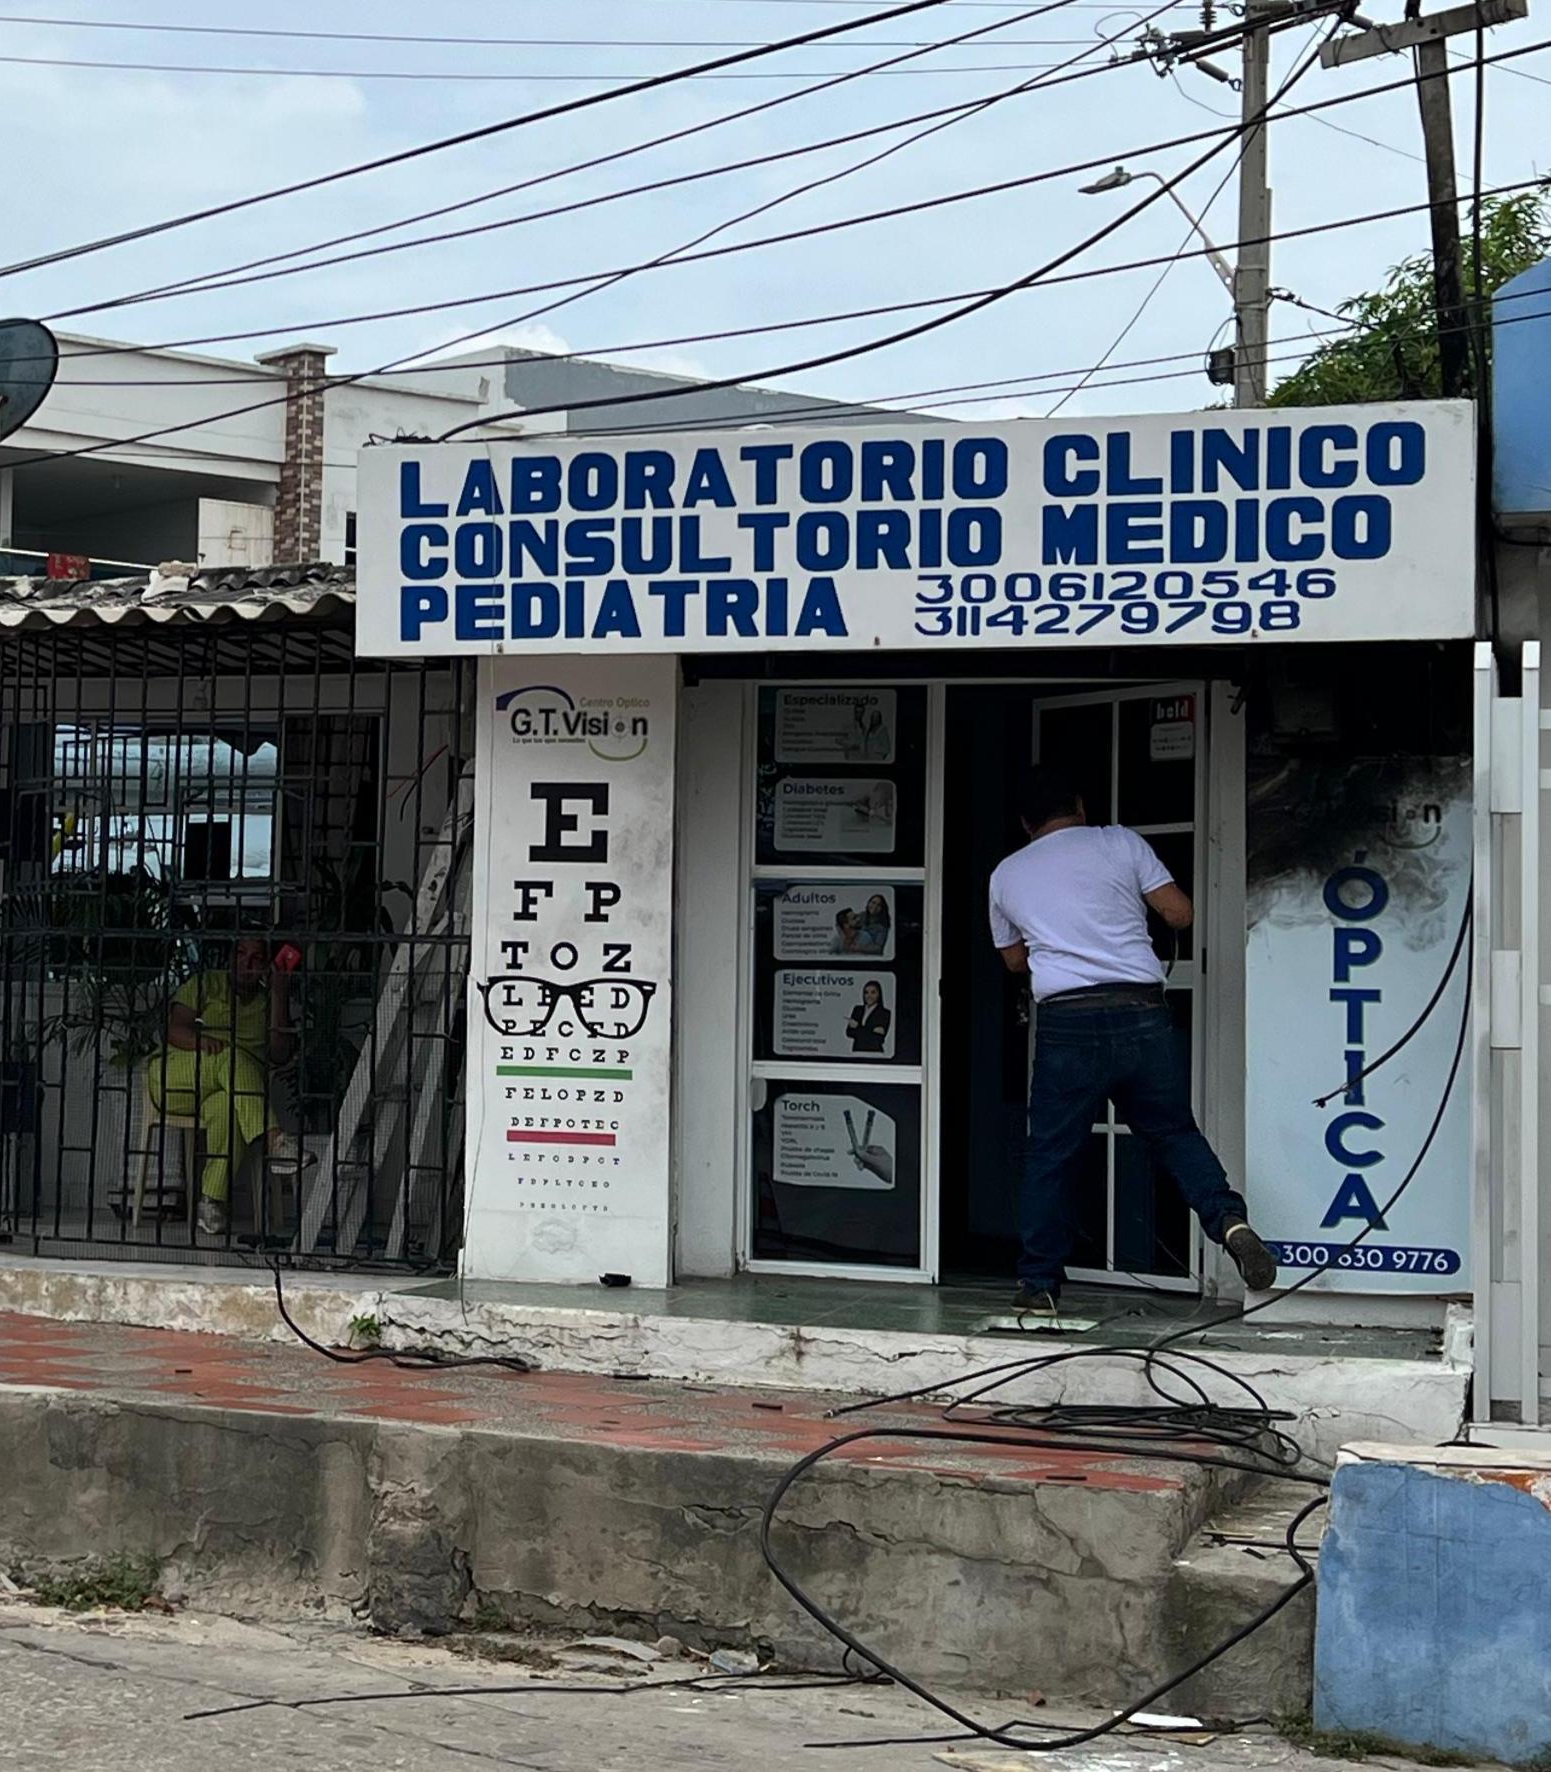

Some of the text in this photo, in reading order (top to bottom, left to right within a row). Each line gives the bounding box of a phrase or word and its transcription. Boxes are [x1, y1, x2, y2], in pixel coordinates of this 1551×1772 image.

[399, 421, 1425, 518] LABORATORIO CLINICO
[399, 494, 1392, 580] CONSULTORIO MEDICO
[399, 566, 1337, 641] PEDIATRIA 3006120546
[914, 599, 1301, 636] 3114279798
[783, 693, 879, 707] Especializado
[783, 782, 845, 795] Diabetes
[529, 782, 610, 864] E
[782, 892, 837, 905] Adultos
[782, 973, 855, 987] Ejecutivos
[781, 1100, 821, 1112] Torch
[1282, 1245, 1329, 1265] 300
[1392, 1250, 1449, 1272] 9776
